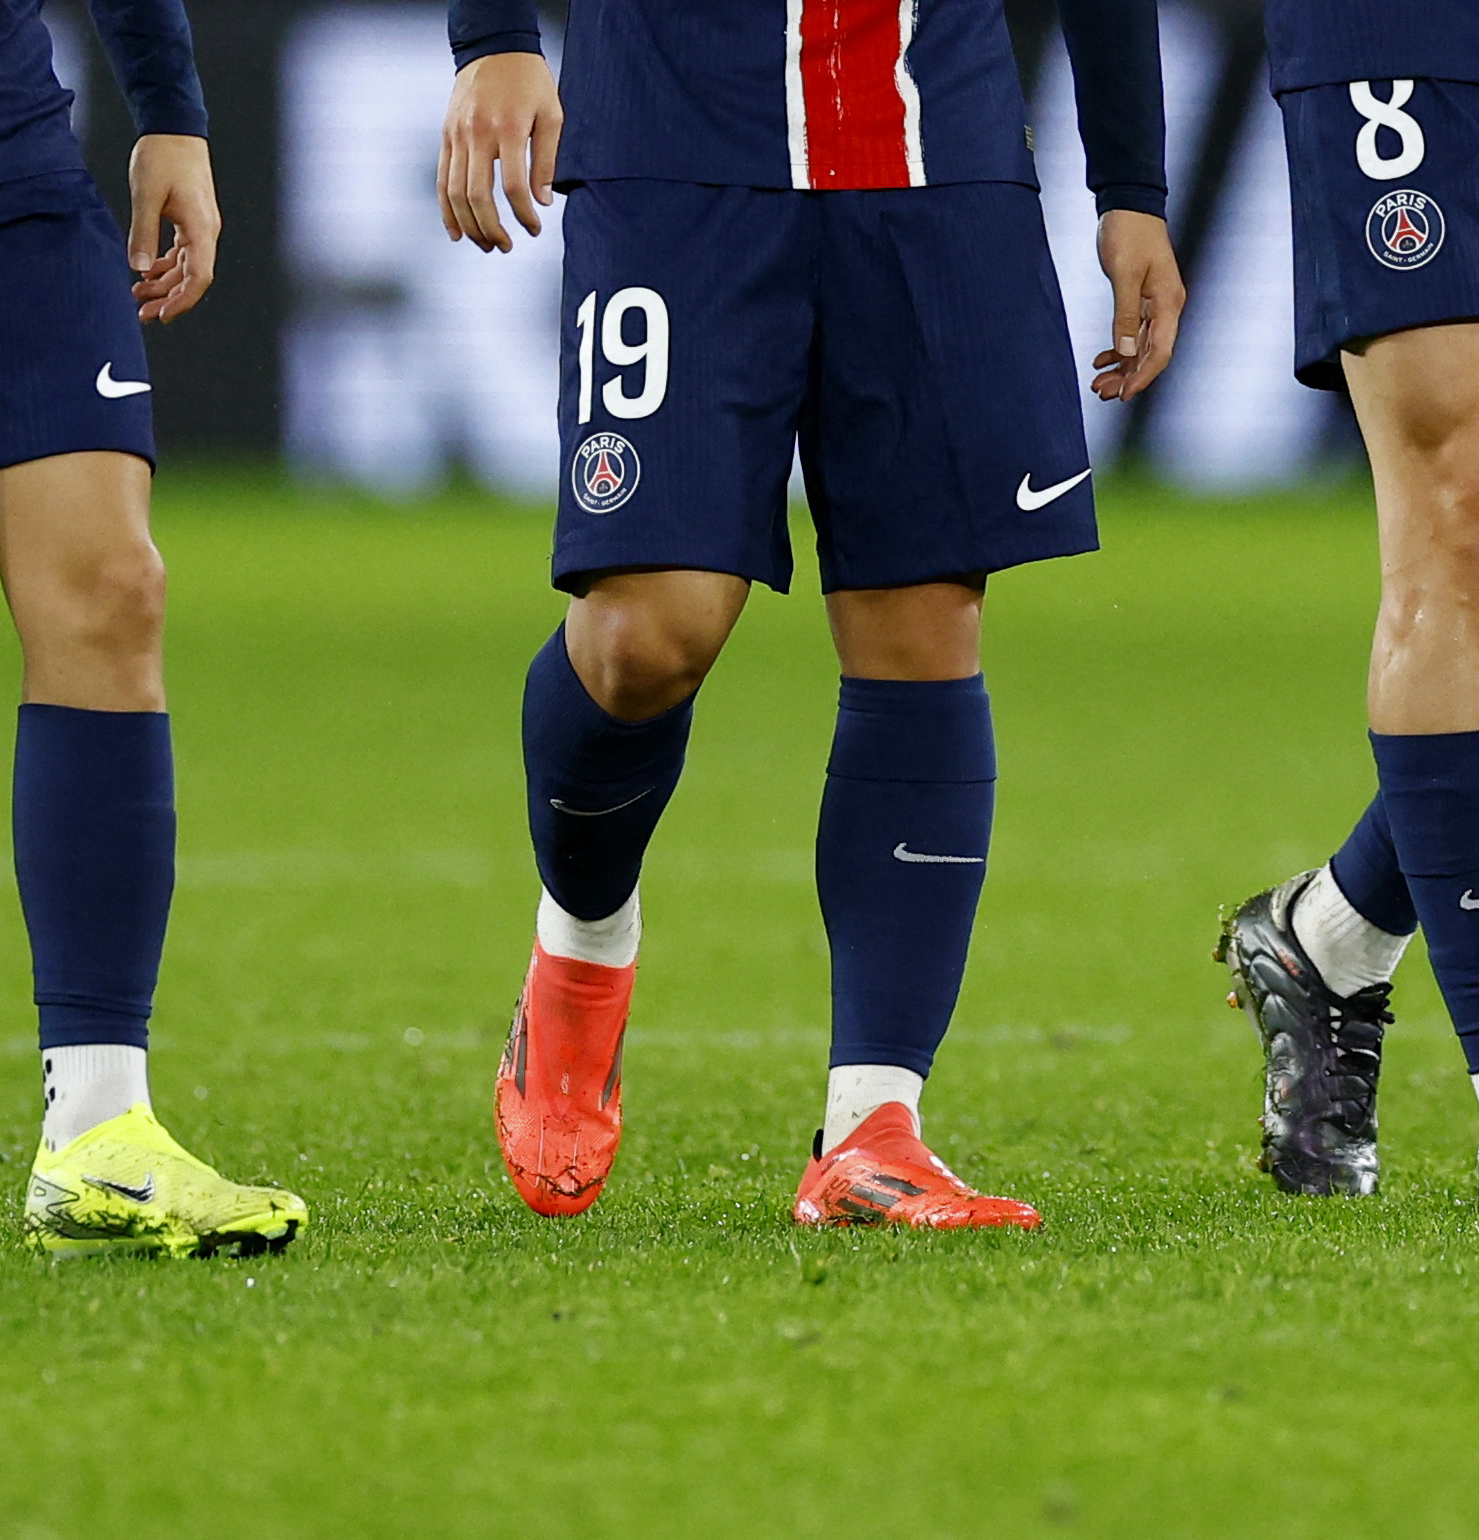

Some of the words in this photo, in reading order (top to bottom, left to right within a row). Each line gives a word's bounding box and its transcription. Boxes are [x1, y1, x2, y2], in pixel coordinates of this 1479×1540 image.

[1349, 79, 1424, 180] 8
[1375, 193, 1427, 218] PARIS
[577, 287, 669, 424] 19
[581, 436, 626, 459] PARIS
